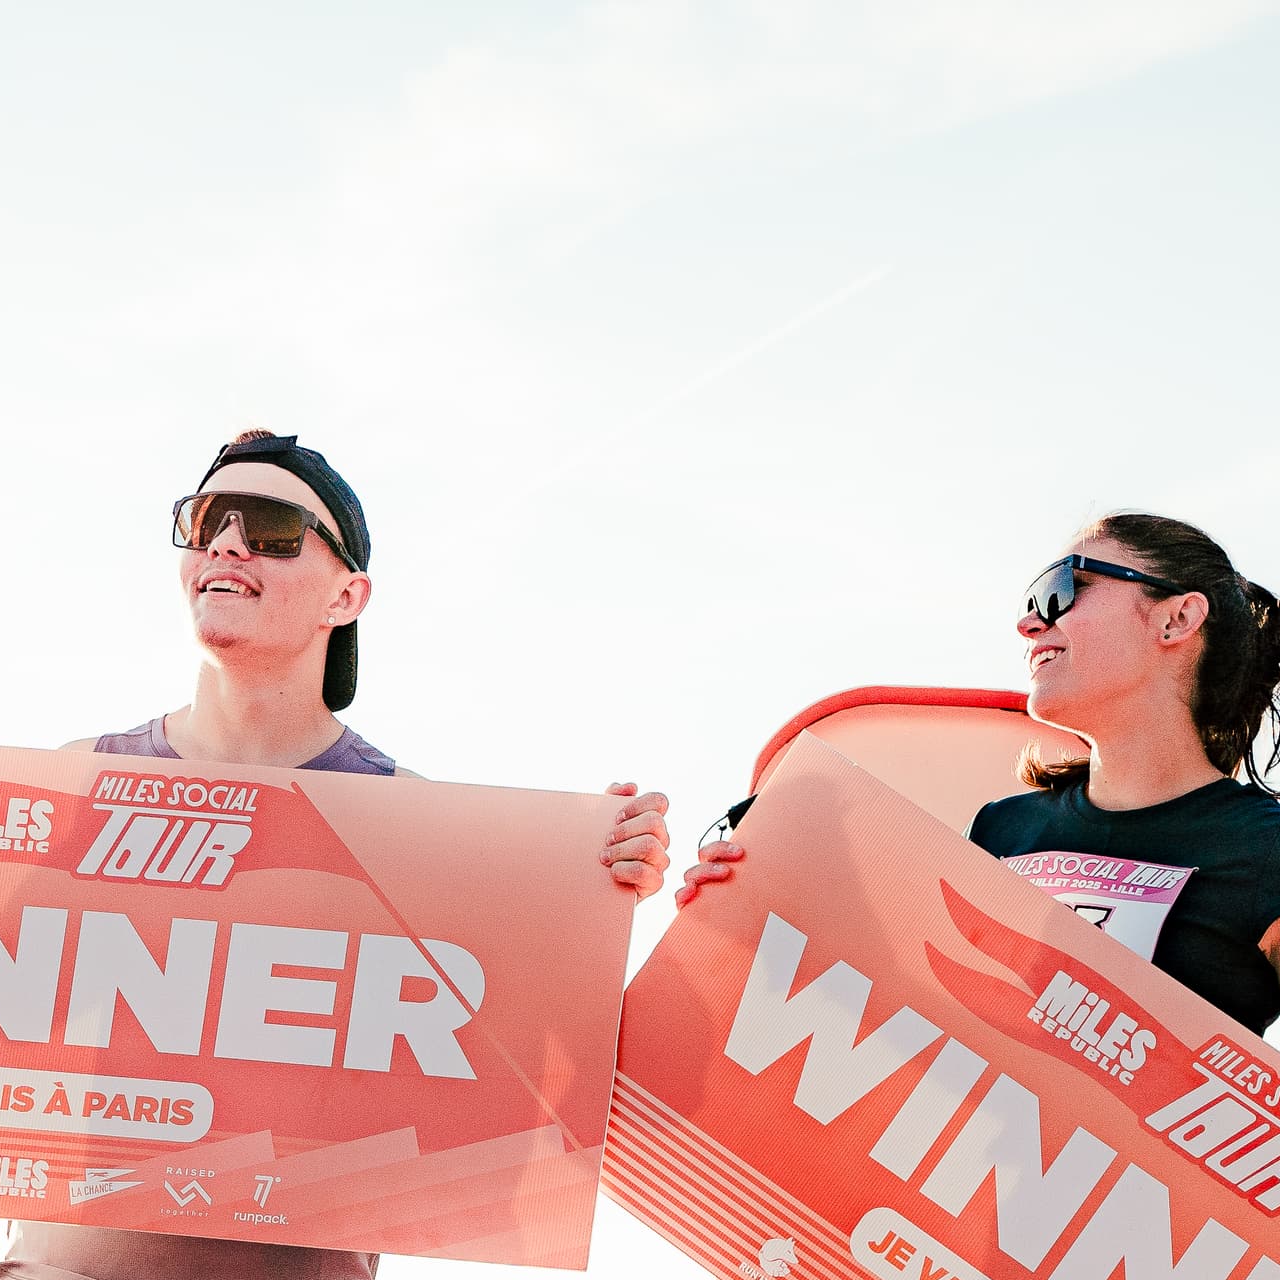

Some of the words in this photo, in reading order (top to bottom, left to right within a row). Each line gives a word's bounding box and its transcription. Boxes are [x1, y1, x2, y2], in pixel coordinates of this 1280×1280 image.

[95, 775, 165, 804] MILES
[166, 781, 259, 812] SOCIAL
[76, 803, 253, 886] TOUR
[1047, 855, 1123, 881] SOCIAL
[1122, 861, 1187, 890] TOUR
[1069, 879, 1102, 890] 2025
[1110, 884, 1145, 897] LILLE
[1026, 1006, 1135, 1086] REPUBLIC
[1199, 1040, 1272, 1095] MILES
[42, 1081, 72, 1117] À
[82, 1090, 195, 1126] PARIS
[71, 1186, 83, 1198] LA
[84, 1182, 114, 1196] CHANCE
[166, 1167, 216, 1178] RAISED
[868, 1230, 917, 1272] JE
